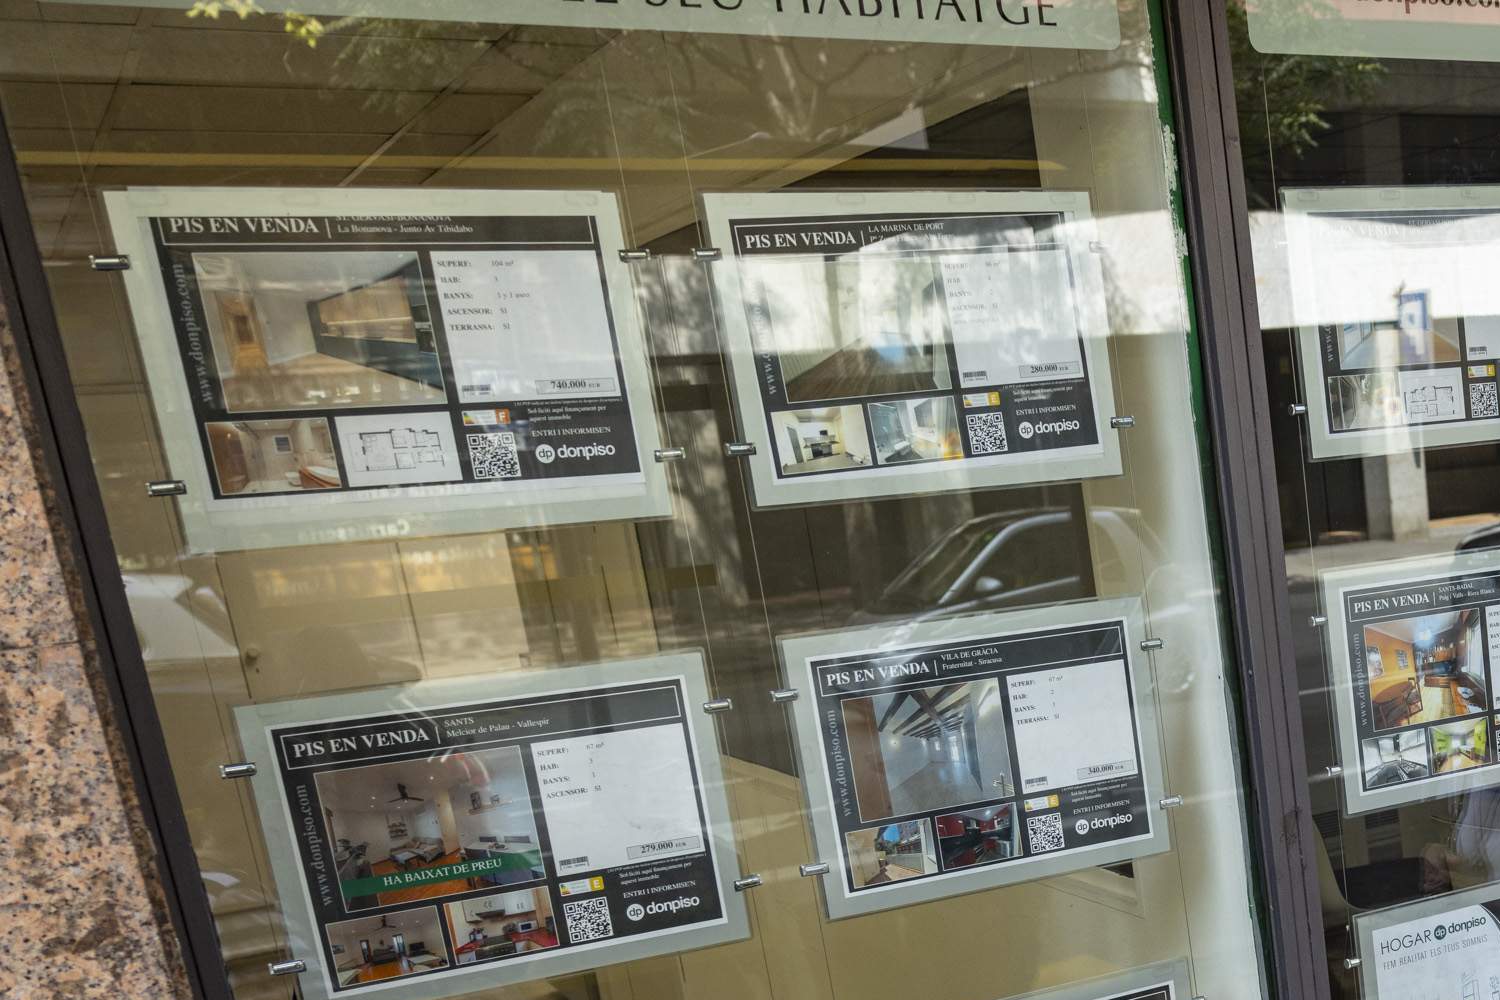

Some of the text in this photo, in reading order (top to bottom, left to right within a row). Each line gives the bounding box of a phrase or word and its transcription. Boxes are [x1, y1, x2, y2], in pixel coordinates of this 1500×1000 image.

[169, 216, 205, 234] PIS
[211, 216, 240, 233] EN
[245, 216, 320, 233] VENDA
[400, 225, 423, 234] Junto
[438, 225, 474, 233] Tibidabo
[868, 222, 944, 233] LA MARINA DE PORT
[744, 234, 771, 249] PIS
[775, 233, 797, 247] EN
[799, 230, 857, 247] VENDA
[440, 276, 461, 284] HAB:
[172, 263, 214, 402] www.donpiso.com
[1031, 364, 1058, 374] 280.000
[551, 380, 587, 389] 740.000
[1015, 407, 1033, 416] ENTRI
[532, 428, 557, 437] ENTRI
[1035, 419, 1080, 435] donpiso
[538, 443, 616, 460] dp donpiso
[1354, 593, 1430, 613] PIS EN VENDA
[941, 647, 999, 662] VILA DE GRÀCIA
[942, 657, 1002, 671] Fraternitat Siracusa
[826, 661, 930, 687] PIS EN VENDA
[1351, 632, 1368, 728] www.donpiso.com
[444, 716, 475, 728] SANTS
[446, 717, 551, 738] Melcior de Palau Vallespir
[293, 728, 430, 758] PIS EN VENDA
[537, 747, 569, 757] SUPERF:
[540, 763, 560, 771] HAB:
[827, 709, 851, 817] www.donpiso.com
[1088, 765, 1114, 775] 340.000
[543, 776, 571, 785] BANYS:
[546, 787, 588, 799] ASCENSOR:
[1074, 806, 1091, 815] ENTRI
[1091, 813, 1133, 830] donpiso
[297, 783, 334, 907] www.donpiso.com
[641, 841, 674, 854] 279.000
[384, 858, 502, 886] HA BAIXAT DE PREU
[623, 880, 696, 898] ENTRI INFORMISE'N
[629, 896, 700, 918] dp donpiso
[1380, 929, 1432, 955] HOGAR
[1447, 916, 1487, 934] donpiso
[1383, 935, 1488, 971] FEM REALITAT ELS TEUS SOMNIS
